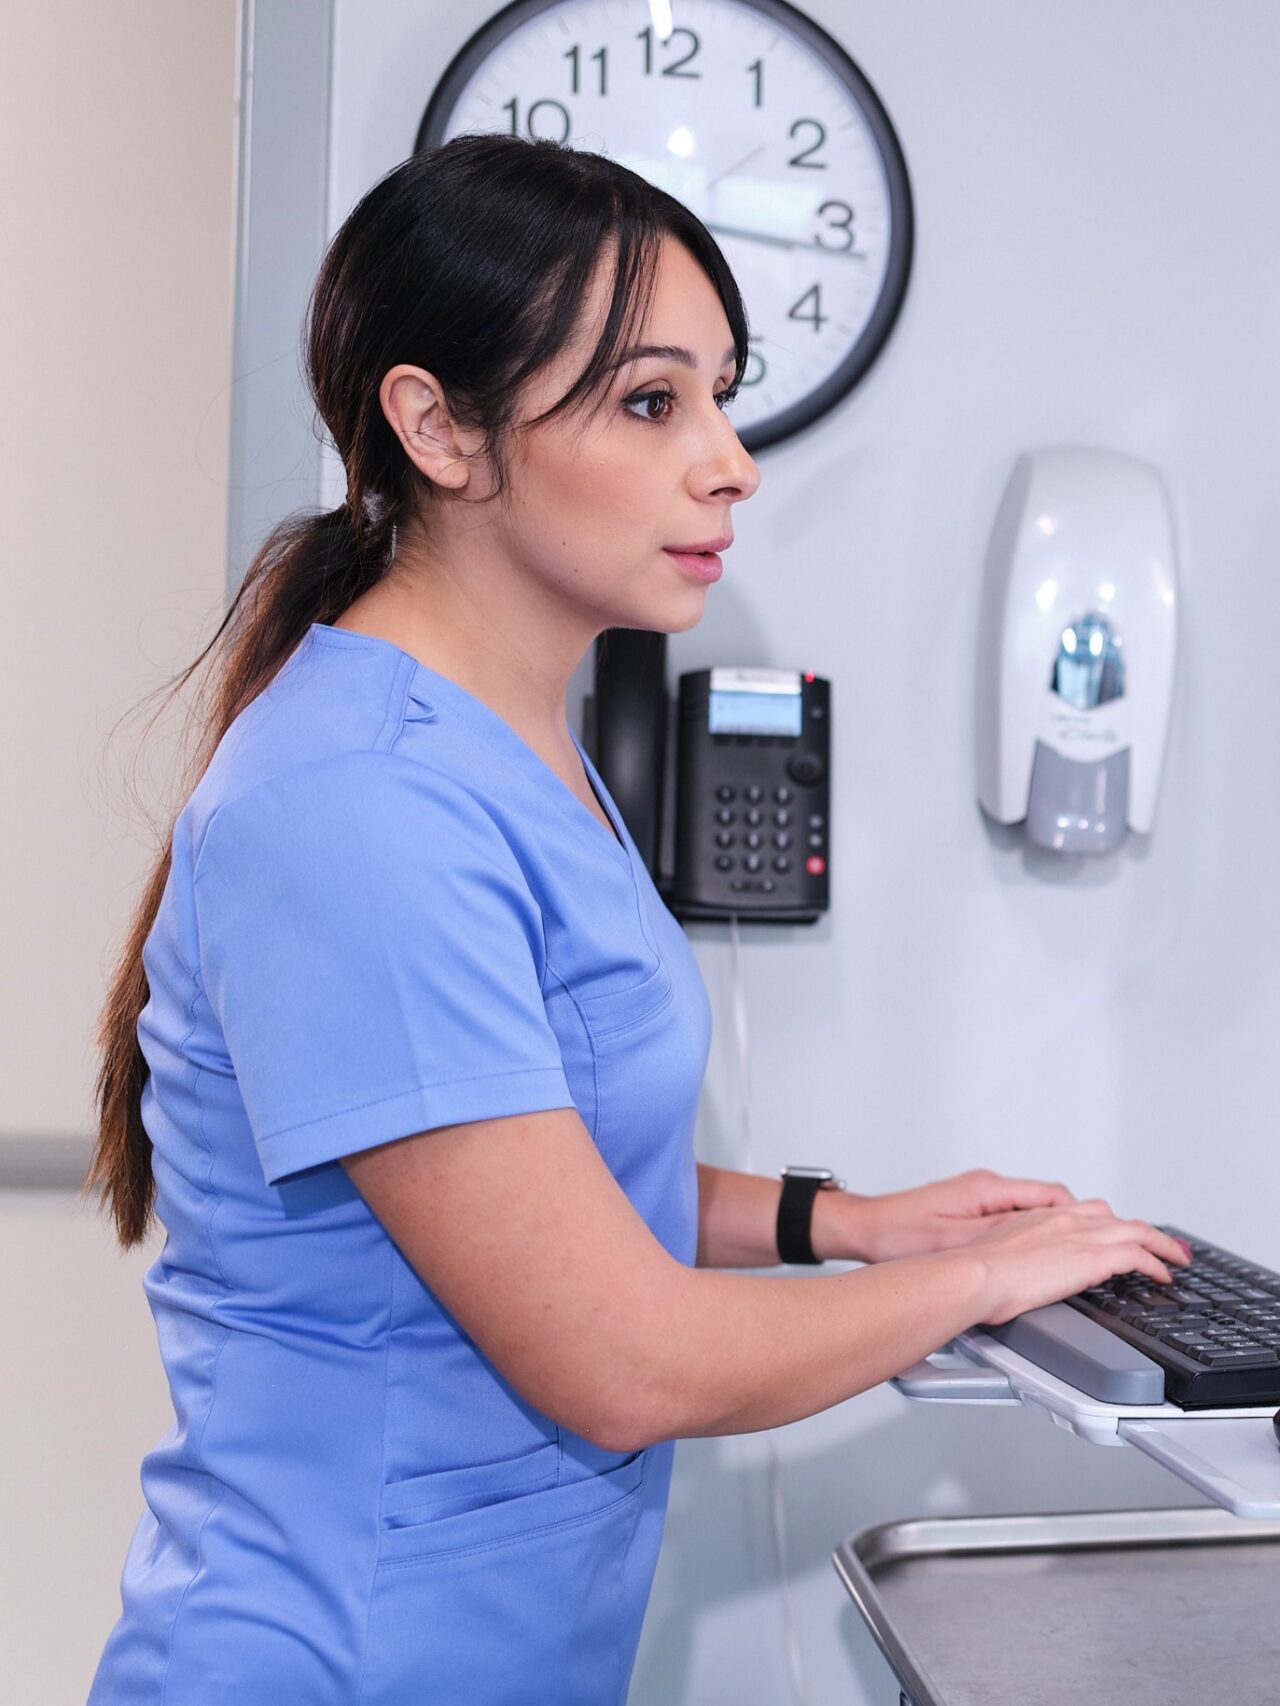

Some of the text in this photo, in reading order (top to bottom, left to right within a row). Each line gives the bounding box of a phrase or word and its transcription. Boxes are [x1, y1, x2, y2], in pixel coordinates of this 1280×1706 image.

[563, 44, 610, 97] 11
[636, 26, 702, 79] 12
[746, 58, 765, 108] 1
[502, 97, 571, 145] 10
[788, 118, 828, 170] 2
[815, 200, 855, 252] 3
[787, 283, 829, 333] 4
